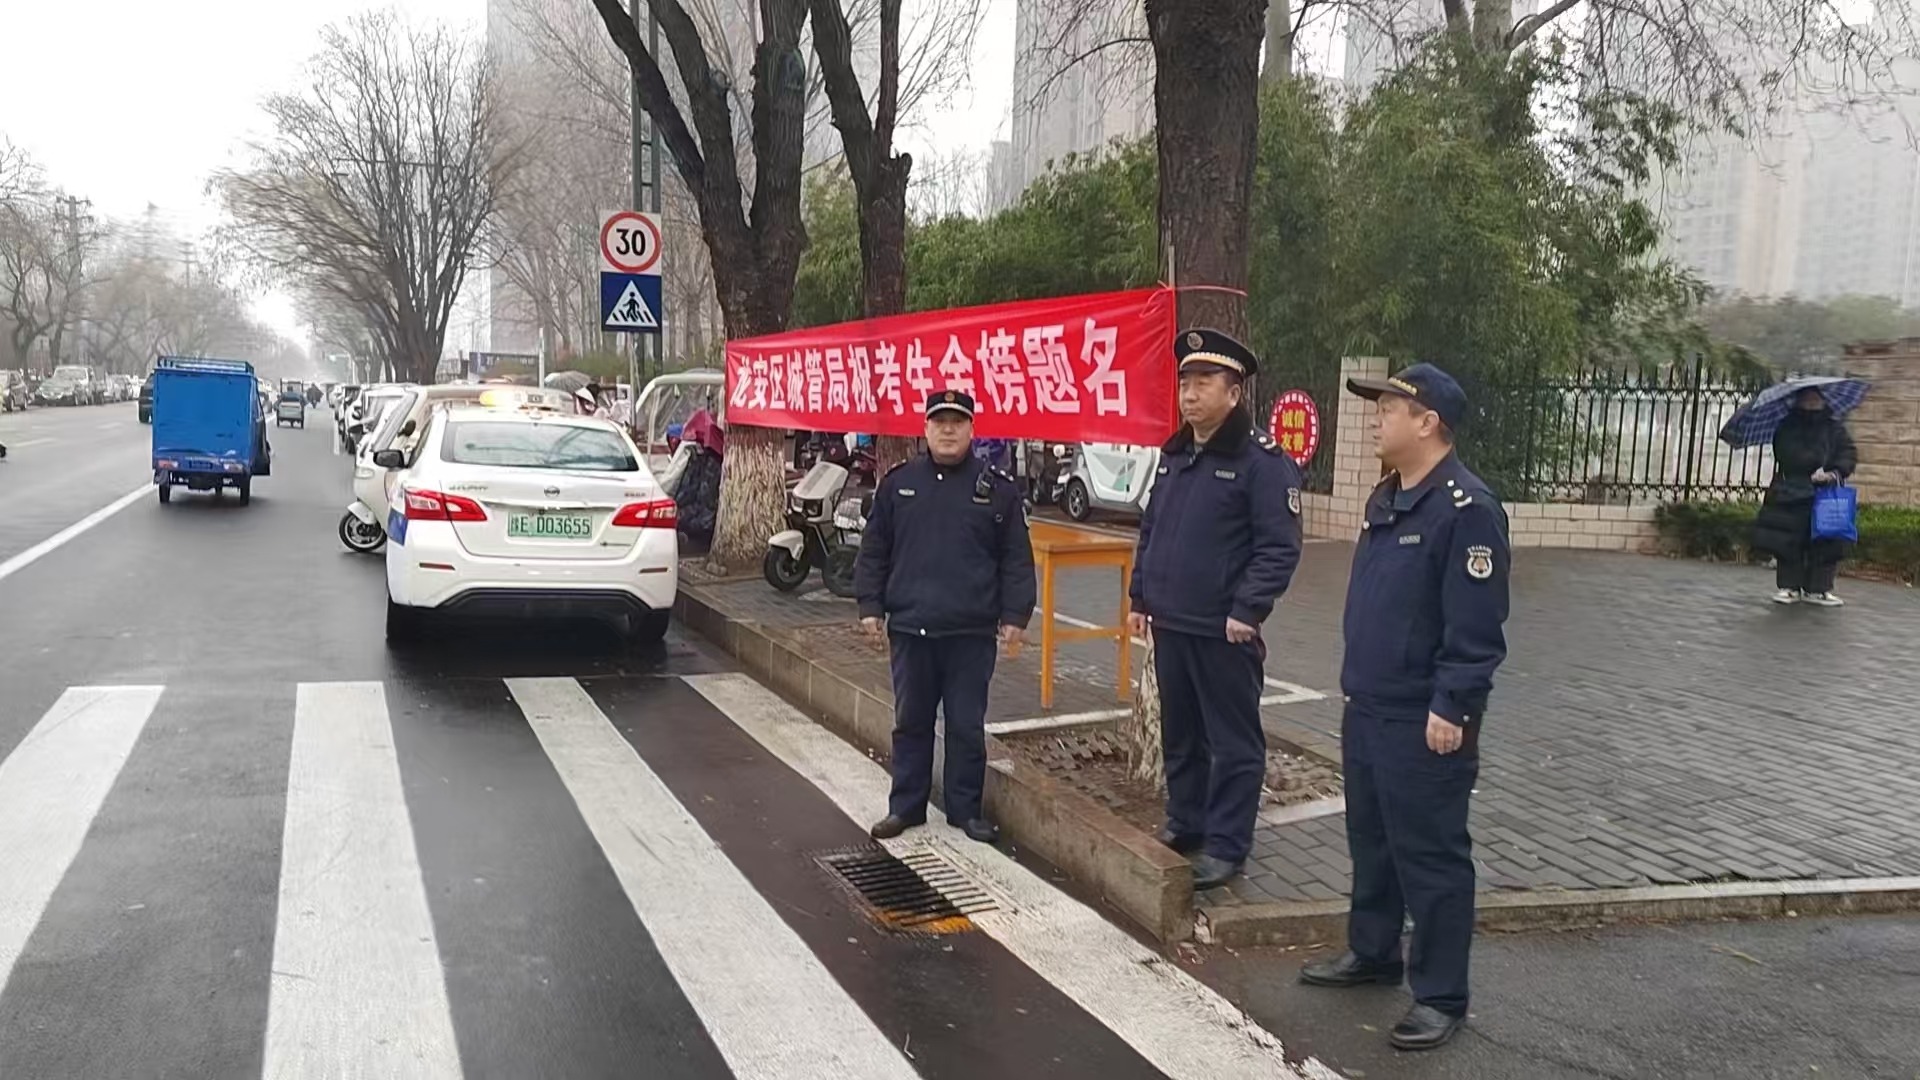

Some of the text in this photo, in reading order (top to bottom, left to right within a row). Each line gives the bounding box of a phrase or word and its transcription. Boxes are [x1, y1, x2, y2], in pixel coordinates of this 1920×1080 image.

[616, 228, 646, 256] 30
[730, 317, 1128, 417] 龙安区城管局祝考生金榜题名
